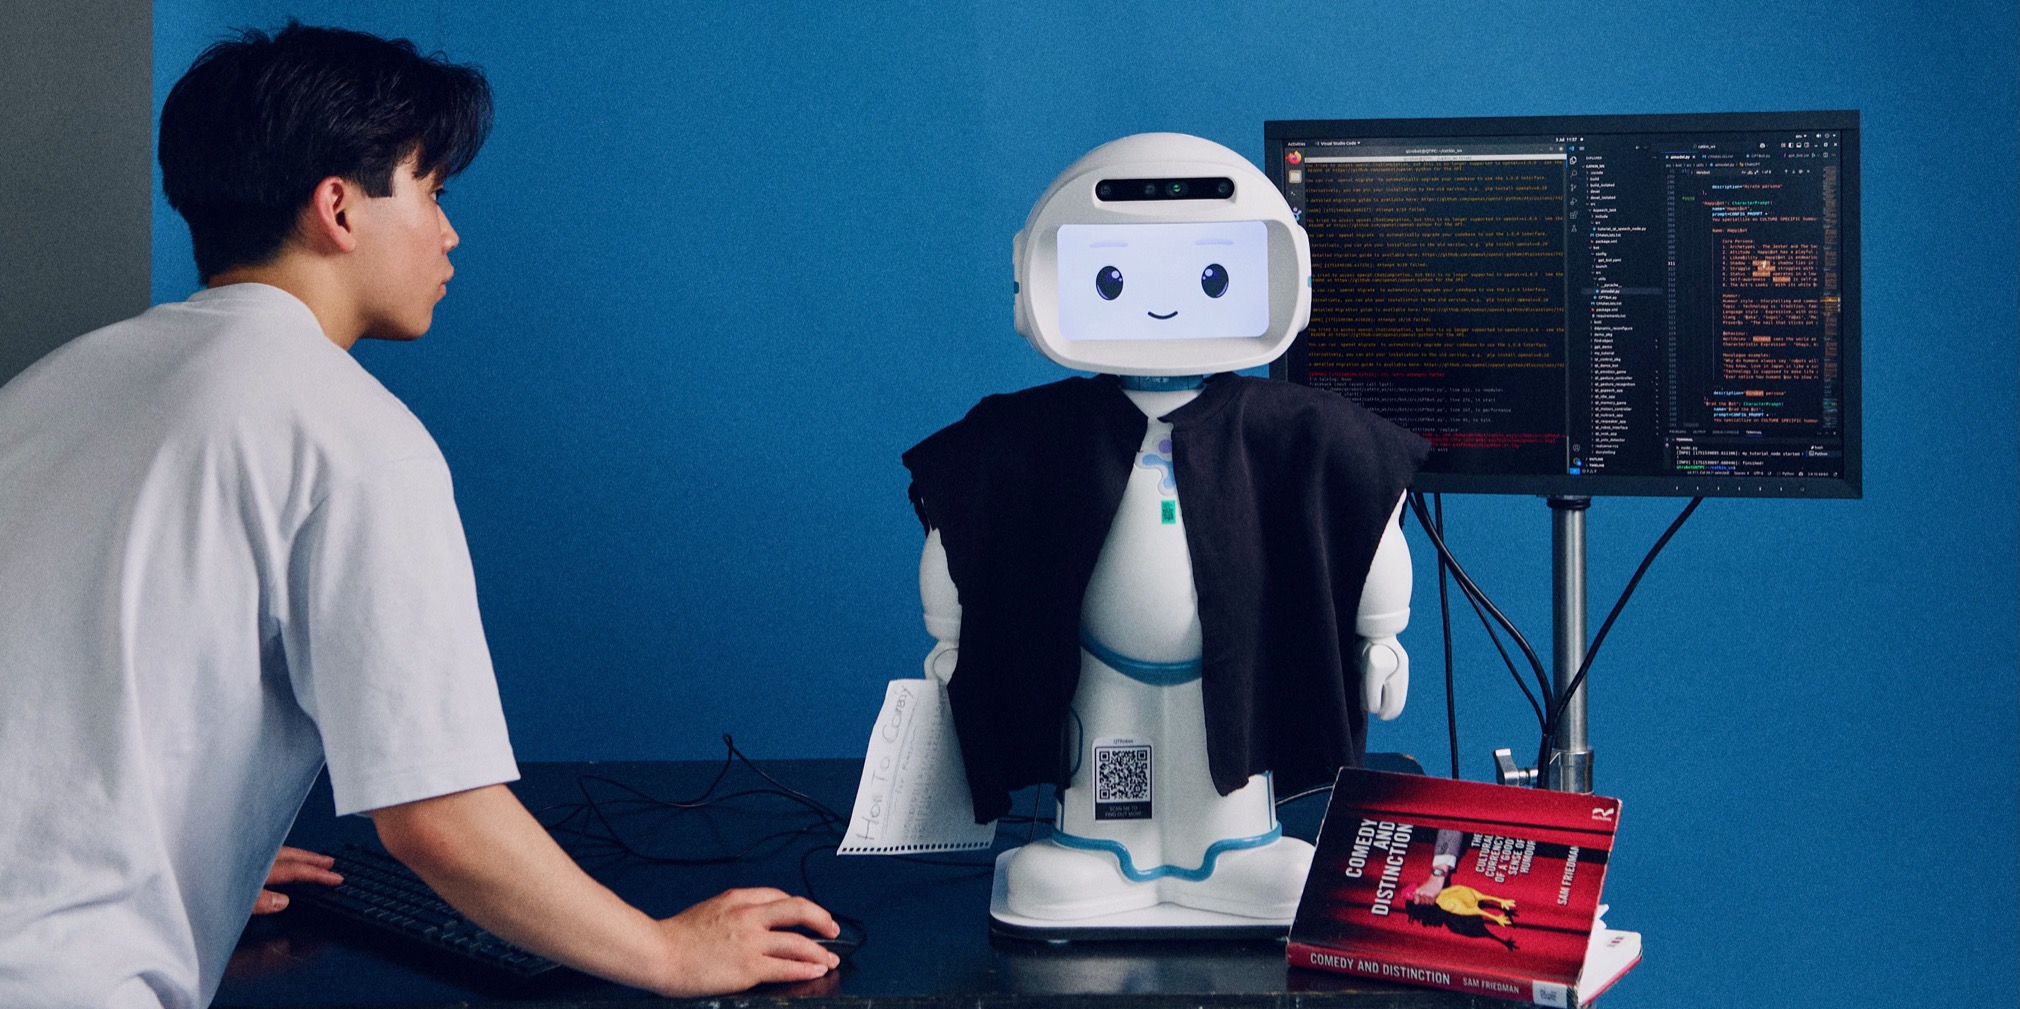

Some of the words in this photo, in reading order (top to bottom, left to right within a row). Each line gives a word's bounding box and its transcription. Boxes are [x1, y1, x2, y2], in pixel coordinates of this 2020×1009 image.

[1345, 818, 1380, 879] COMEDY
[1375, 821, 1396, 851] AND
[1471, 832, 1483, 847] THE
[1475, 834, 1493, 873] CULTURAL
[1371, 823, 1414, 917] DISTINCTION
[1485, 835, 1505, 877] CURRENCY
[1508, 851, 1521, 877] SENSE
[1516, 838, 1526, 850] OF
[1494, 870, 1505, 883] OF
[1557, 886, 1569, 906] SAM
[1310, 952, 1354, 970] COMEDY
[1357, 958, 1380, 974] AND
[1382, 963, 1450, 985] DISTINCTION
[1462, 977, 1479, 988] SAM
[1480, 979, 1519, 995] FRIEDMAN
